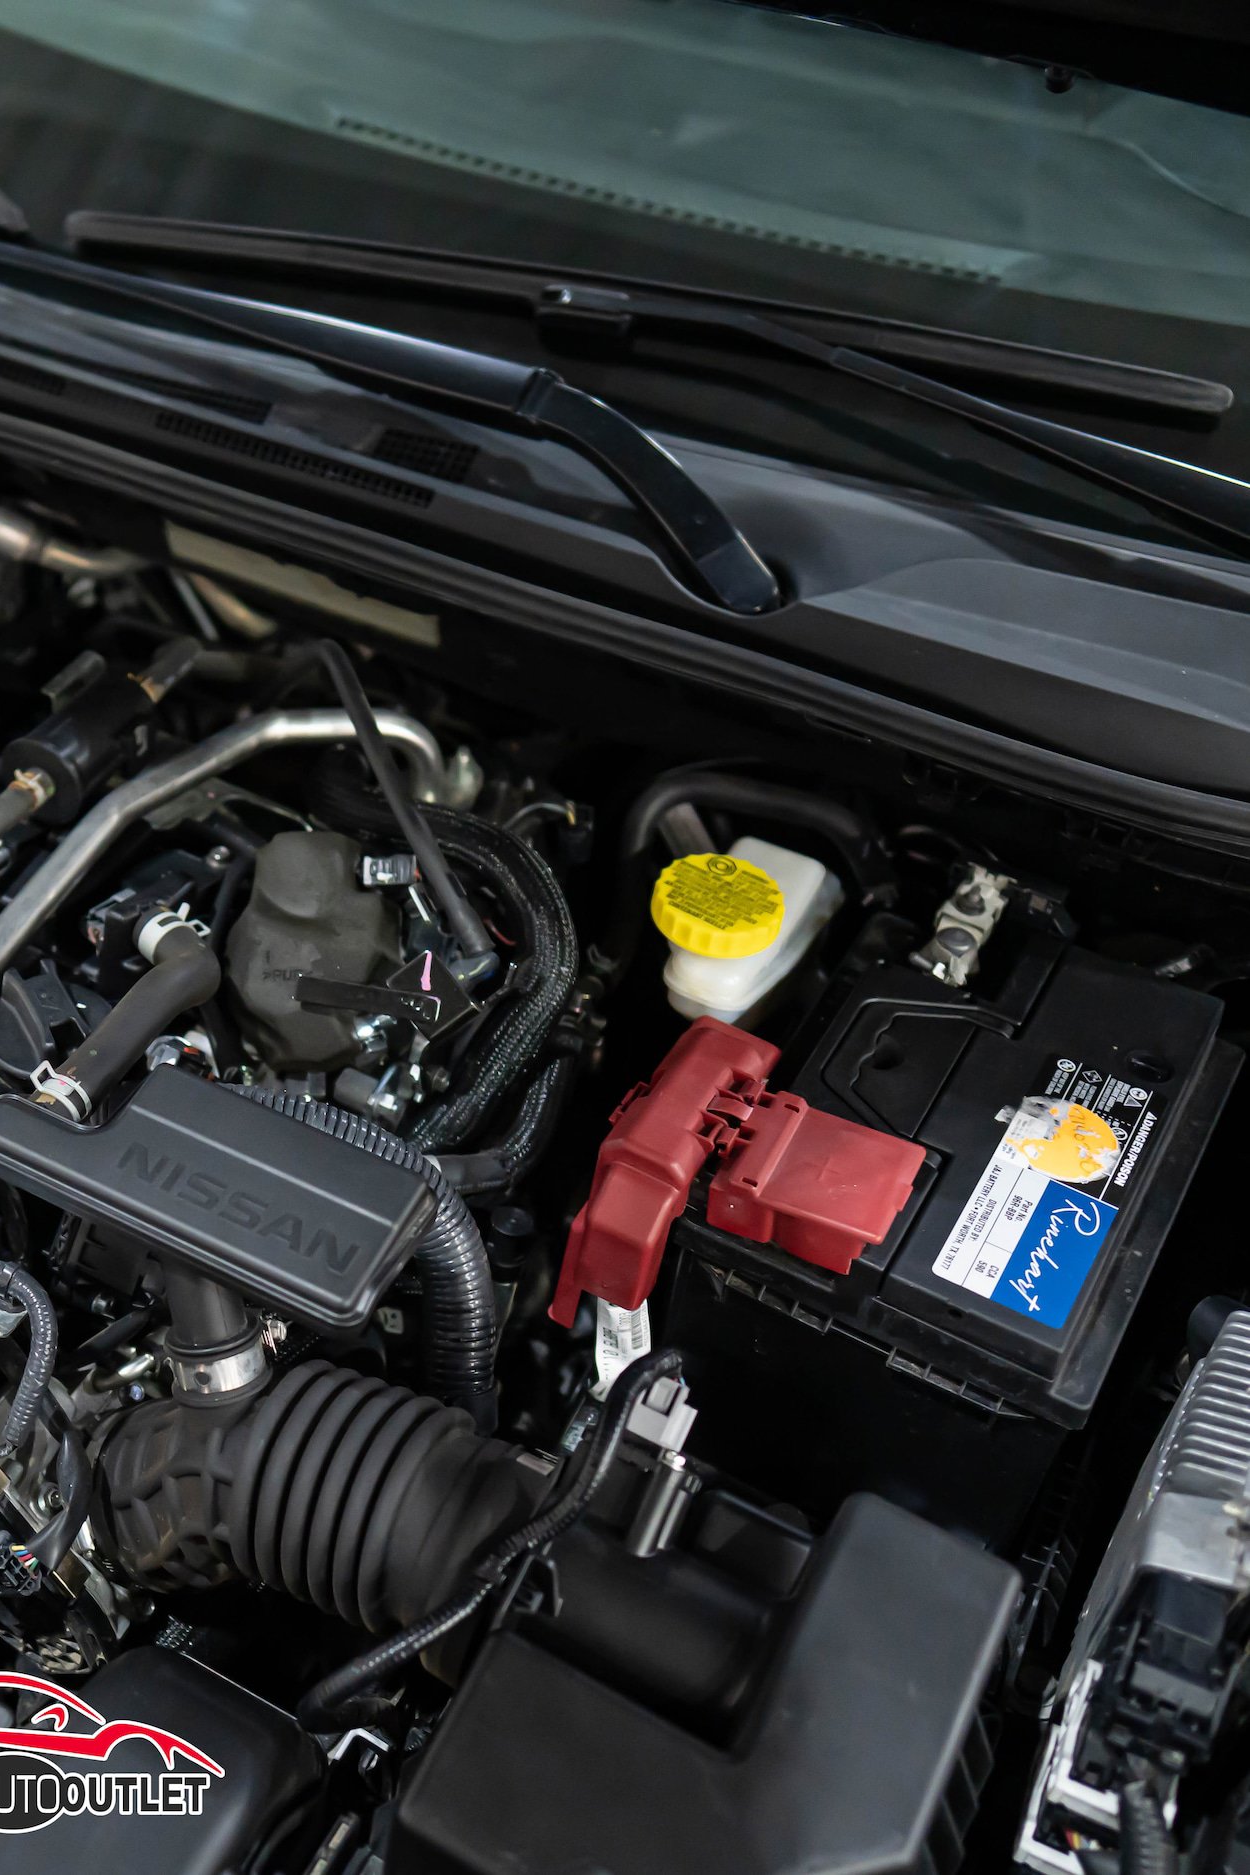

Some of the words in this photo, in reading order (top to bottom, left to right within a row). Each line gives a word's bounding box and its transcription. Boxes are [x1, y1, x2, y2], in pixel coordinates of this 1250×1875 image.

[1113, 1117, 1154, 1187] DANGER/POISON
[991, 1163, 1002, 1176] J&J
[979, 1173, 997, 1197] BATTERY
[973, 1195, 985, 1208] LLC
[1018, 1199, 1032, 1214] Part
[117, 1142, 361, 1278] NISSAN
[964, 1209, 977, 1225] FORT
[973, 1198, 997, 1234] DISTRIBUTED
[1013, 1211, 1026, 1224] No.
[968, 1231, 979, 1243] BY:
[948, 1244, 959, 1255] TX
[1009, 1198, 1100, 1312] Rinehart
[974, 1259, 987, 1273] 590
[985, 1264, 999, 1279] CCA
